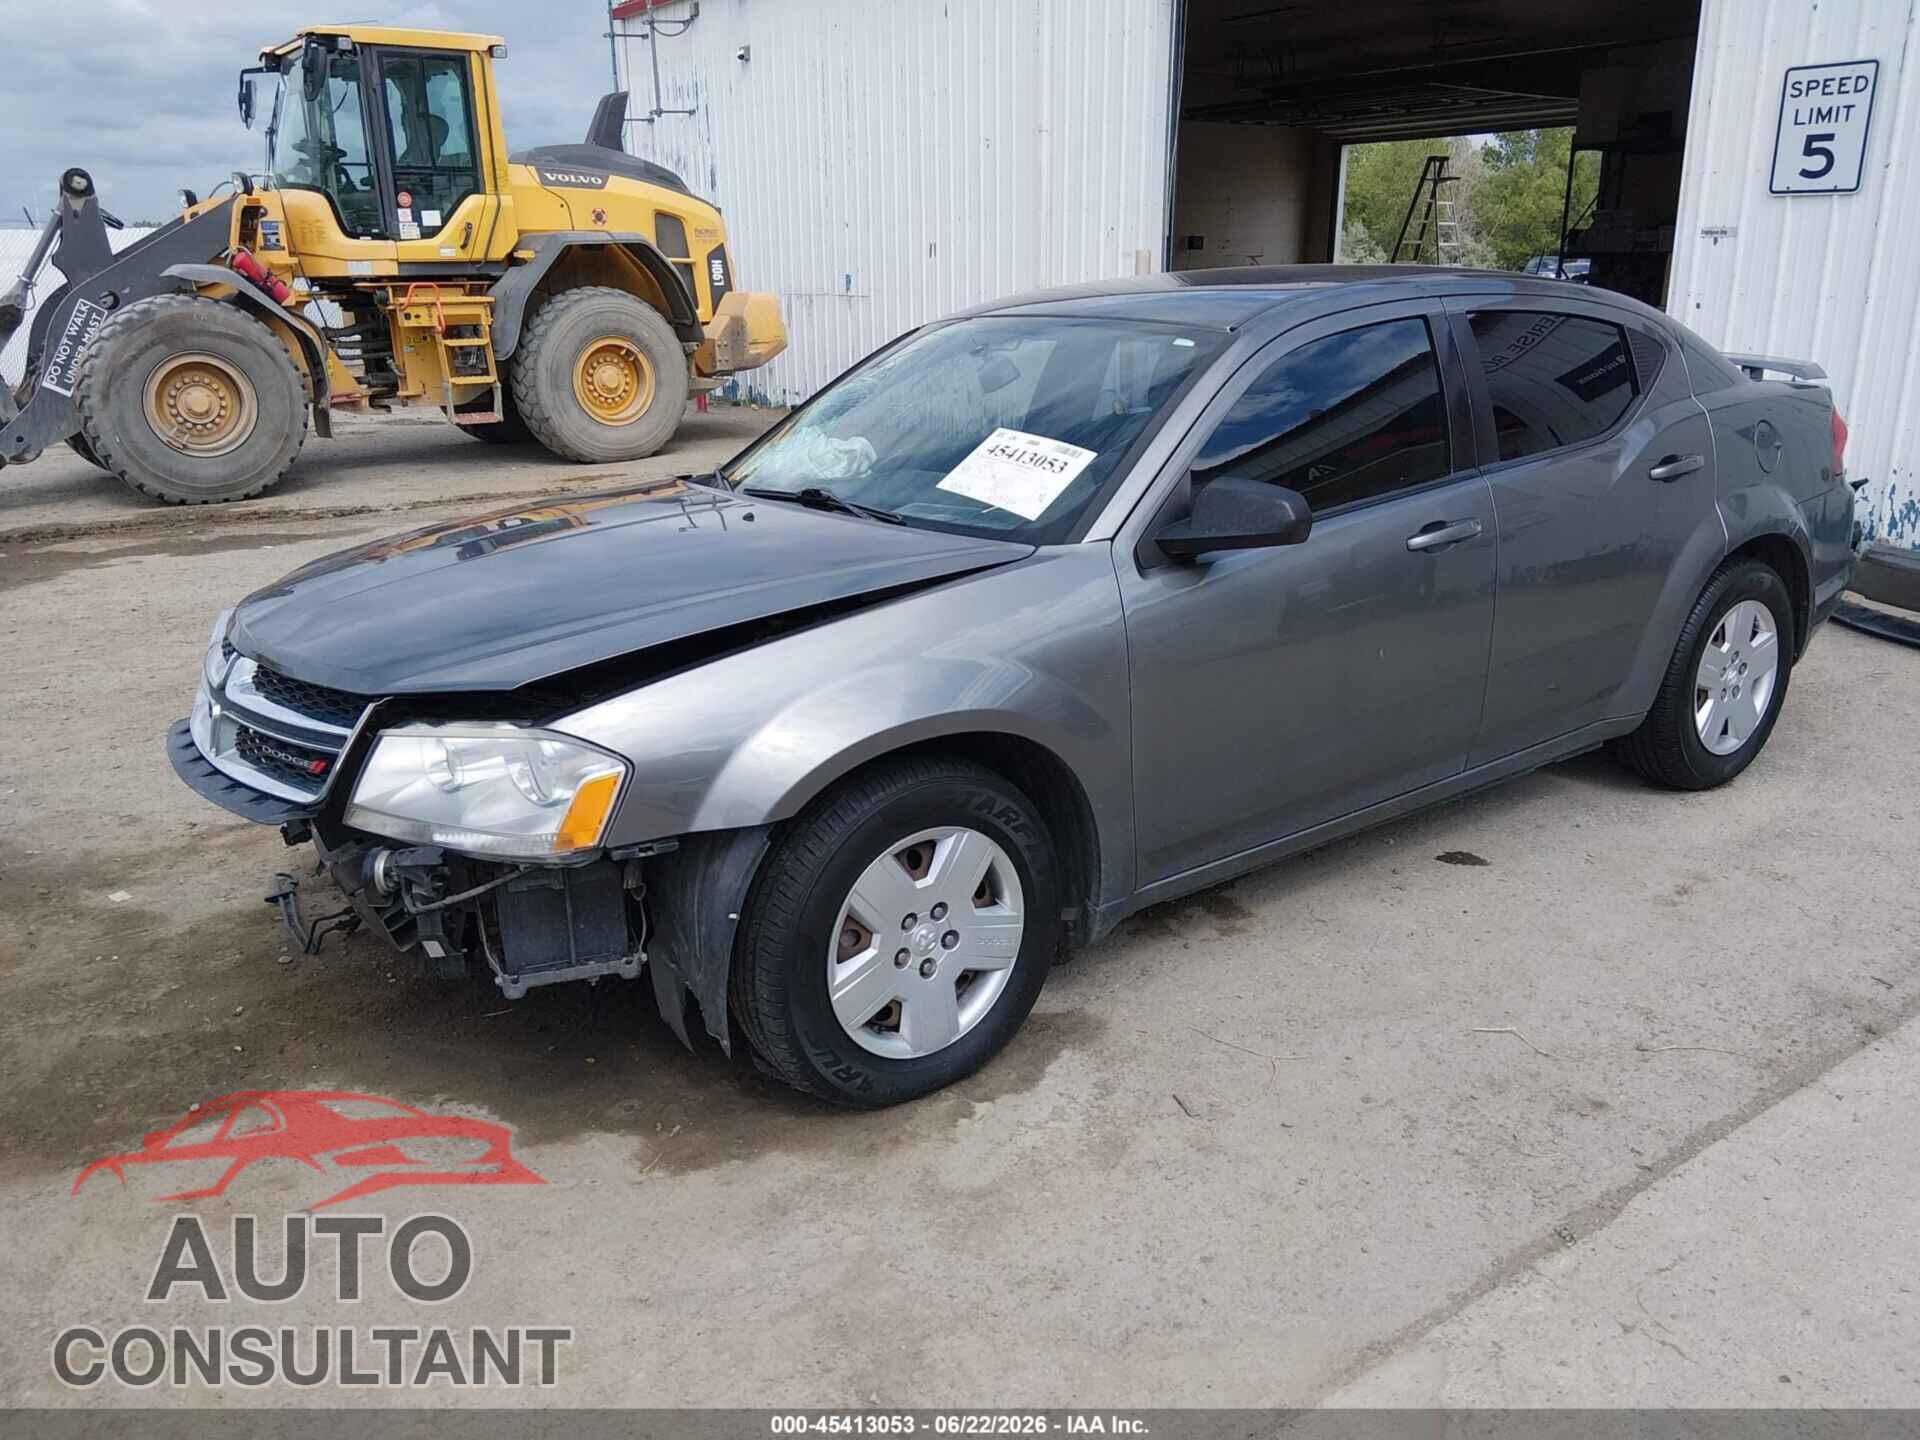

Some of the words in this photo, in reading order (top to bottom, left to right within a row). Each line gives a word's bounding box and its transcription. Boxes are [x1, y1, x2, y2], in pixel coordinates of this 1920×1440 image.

[1790, 75, 1869, 99] SPEED
[1793, 104, 1856, 126] LIMIT
[1798, 133, 1836, 180] 5
[543, 172, 602, 185] VOLVO
[710, 259, 725, 286] L90H
[81, 312, 102, 344] MAST
[46, 365, 62, 385] DO
[56, 337, 74, 364] NOT
[67, 302, 91, 336] WALK
[987, 443, 1069, 475] 45413053
[261, 744, 312, 768] DODGE
